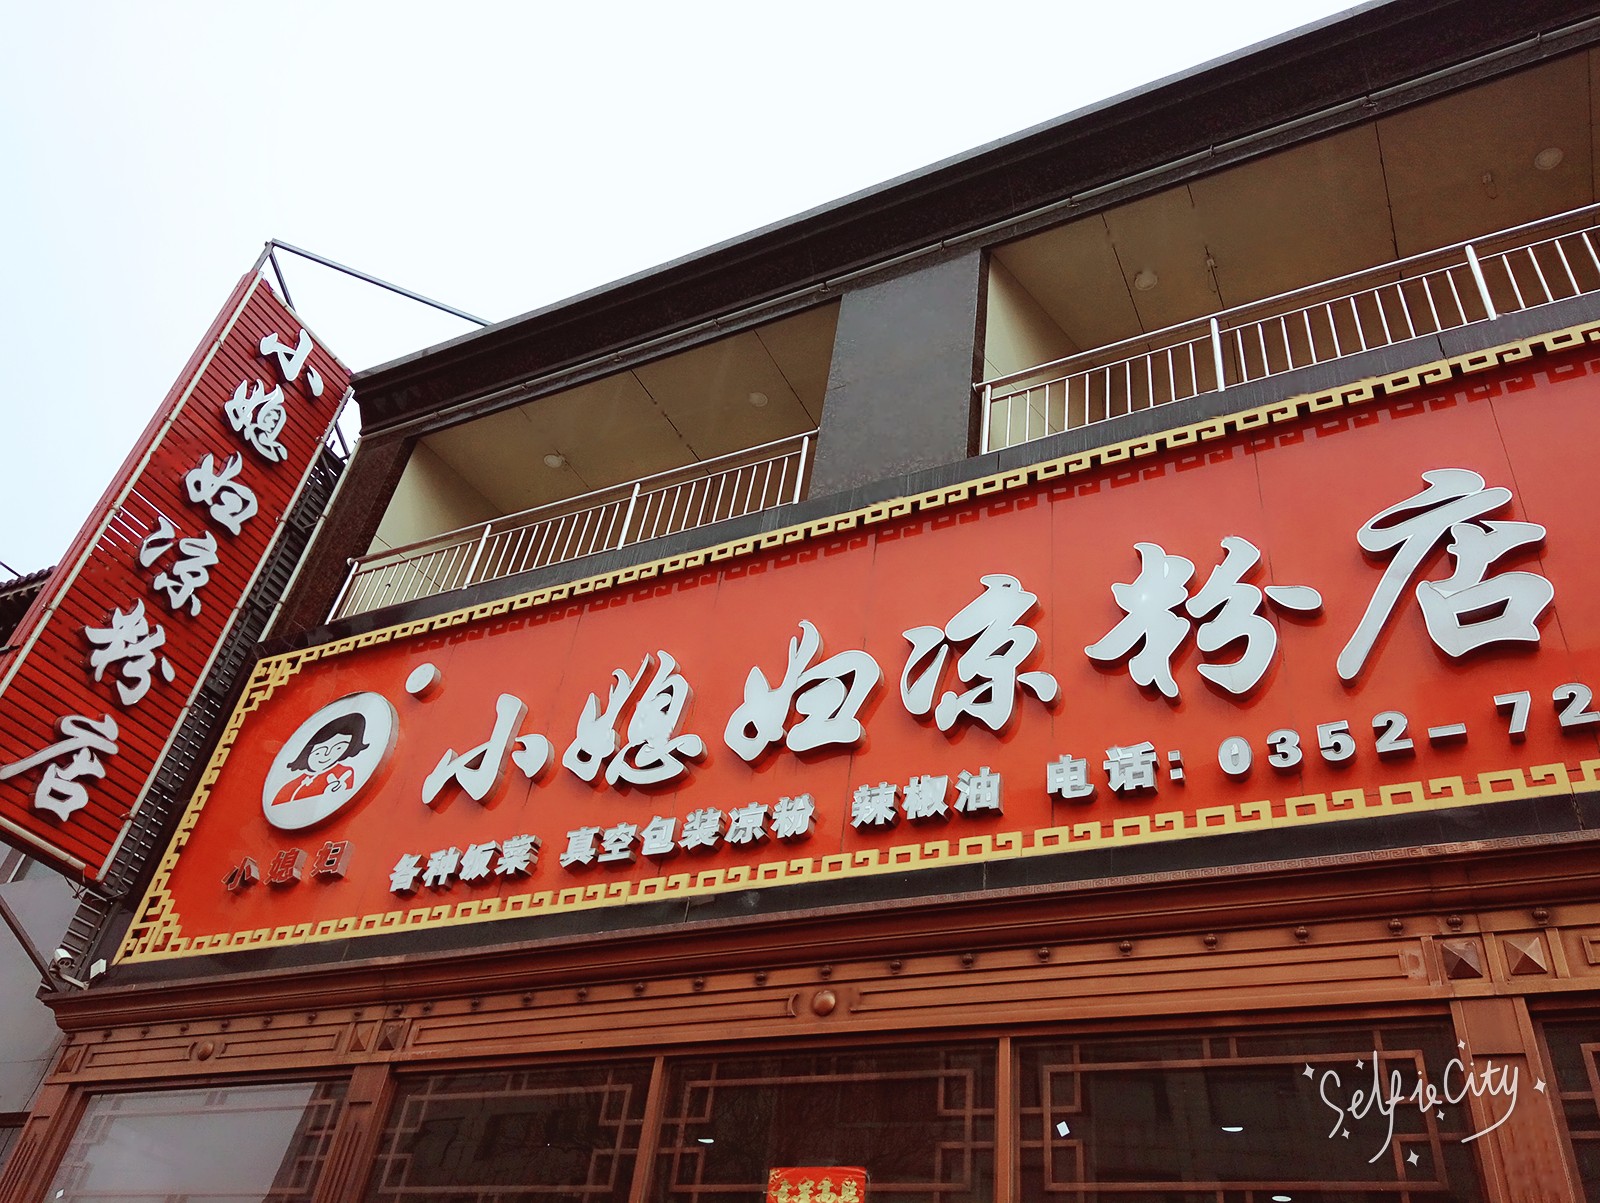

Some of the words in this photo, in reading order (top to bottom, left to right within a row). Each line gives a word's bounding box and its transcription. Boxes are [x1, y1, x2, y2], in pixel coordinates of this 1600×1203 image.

[0, 328, 326, 823] 小媳妇凉粉店
[421, 467, 1556, 805] 小媳妇凉粉店
[221, 840, 354, 892] 小媳妇
[389, 833, 543, 894] 各种饭菜
[559, 793, 818, 869] 真空包装凉粉
[850, 766, 1003, 829] 辣椒油
